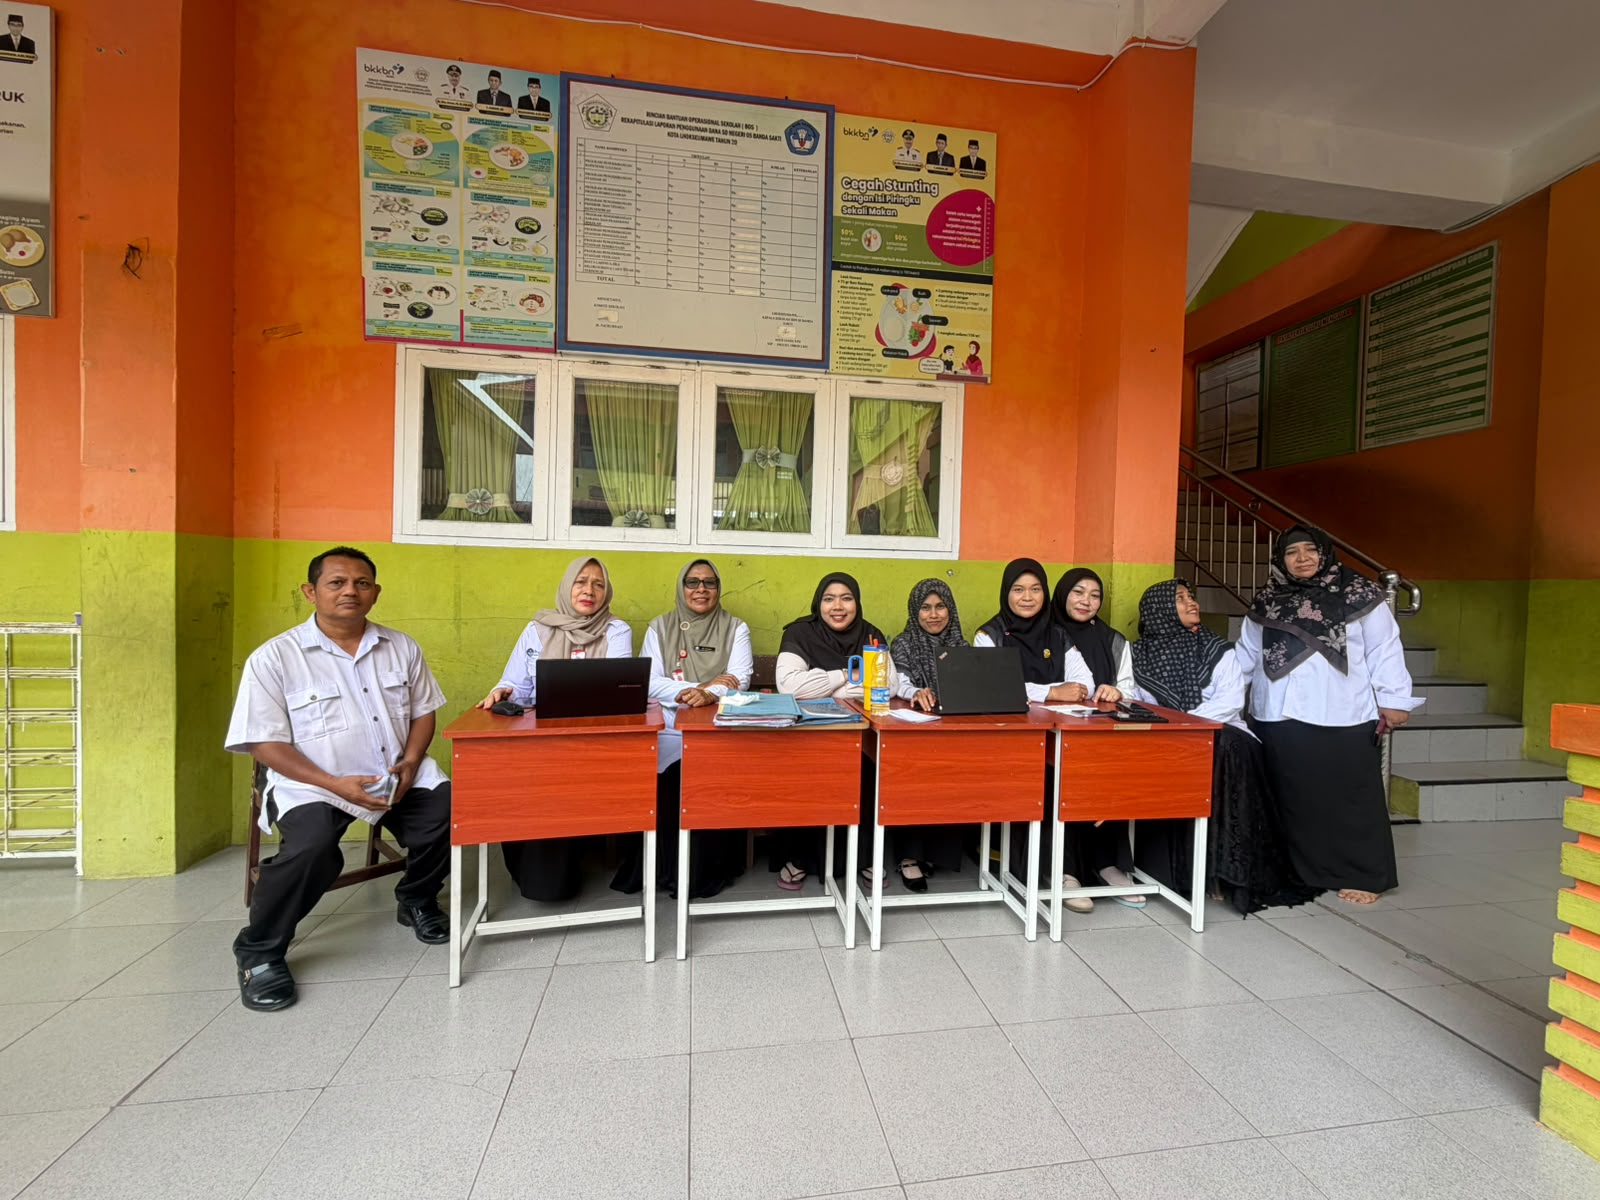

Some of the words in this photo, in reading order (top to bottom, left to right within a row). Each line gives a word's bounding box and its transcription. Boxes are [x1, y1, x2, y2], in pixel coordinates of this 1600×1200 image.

[364, 64, 394, 76] bkkbn
[621, 116, 654, 126] REKAPITULASI
[654, 121, 675, 129] LAPORAN
[676, 124, 708, 133] PENGGUNAAN
[646, 111, 666, 120] RINCIAN
[666, 114, 688, 122] BANTUAN
[689, 116, 720, 126] OPERASIONAL
[680, 133, 715, 143] LHOKSEUMAWE
[843, 127, 870, 138] bkkbn
[842, 177, 884, 194] Cegah
[884, 179, 938, 196] Stunting
[842, 192, 874, 204] dengan
[885, 196, 920, 206] Piringku
[842, 206, 868, 215] Sekali
